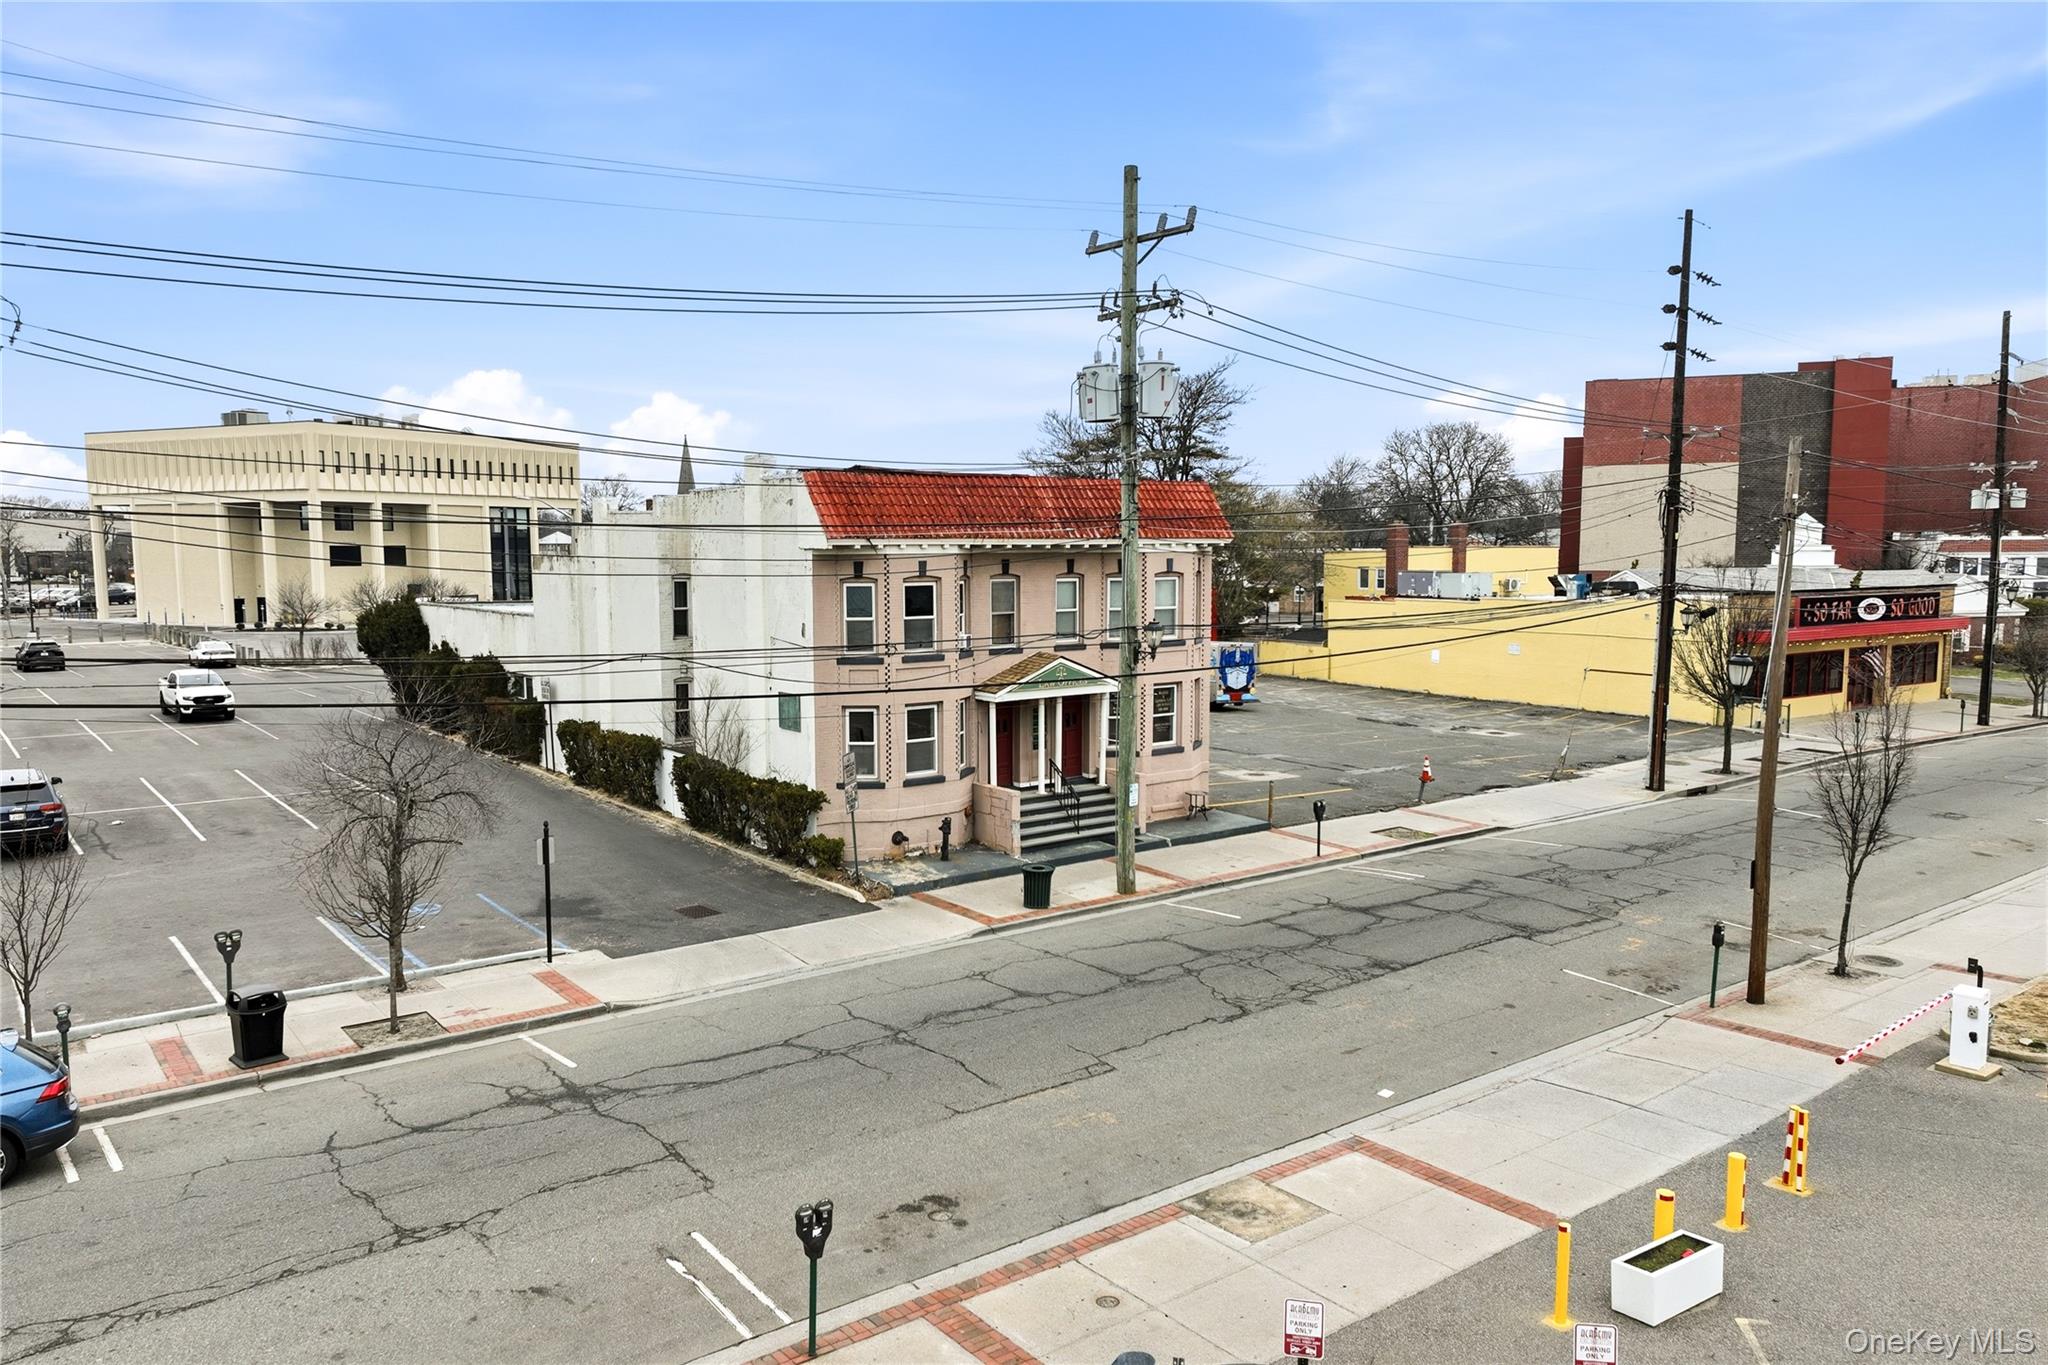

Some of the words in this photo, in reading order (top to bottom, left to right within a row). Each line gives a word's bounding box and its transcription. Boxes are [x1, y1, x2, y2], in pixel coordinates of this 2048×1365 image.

[1813, 602, 1828, 622] SO
[1831, 600, 1852, 621] FAR
[1890, 598, 1905, 617] SO
[1908, 596, 1936, 615] GOOD
[1289, 1320, 1319, 1328] PARKING
[1580, 1345, 1611, 1354] PARKING
